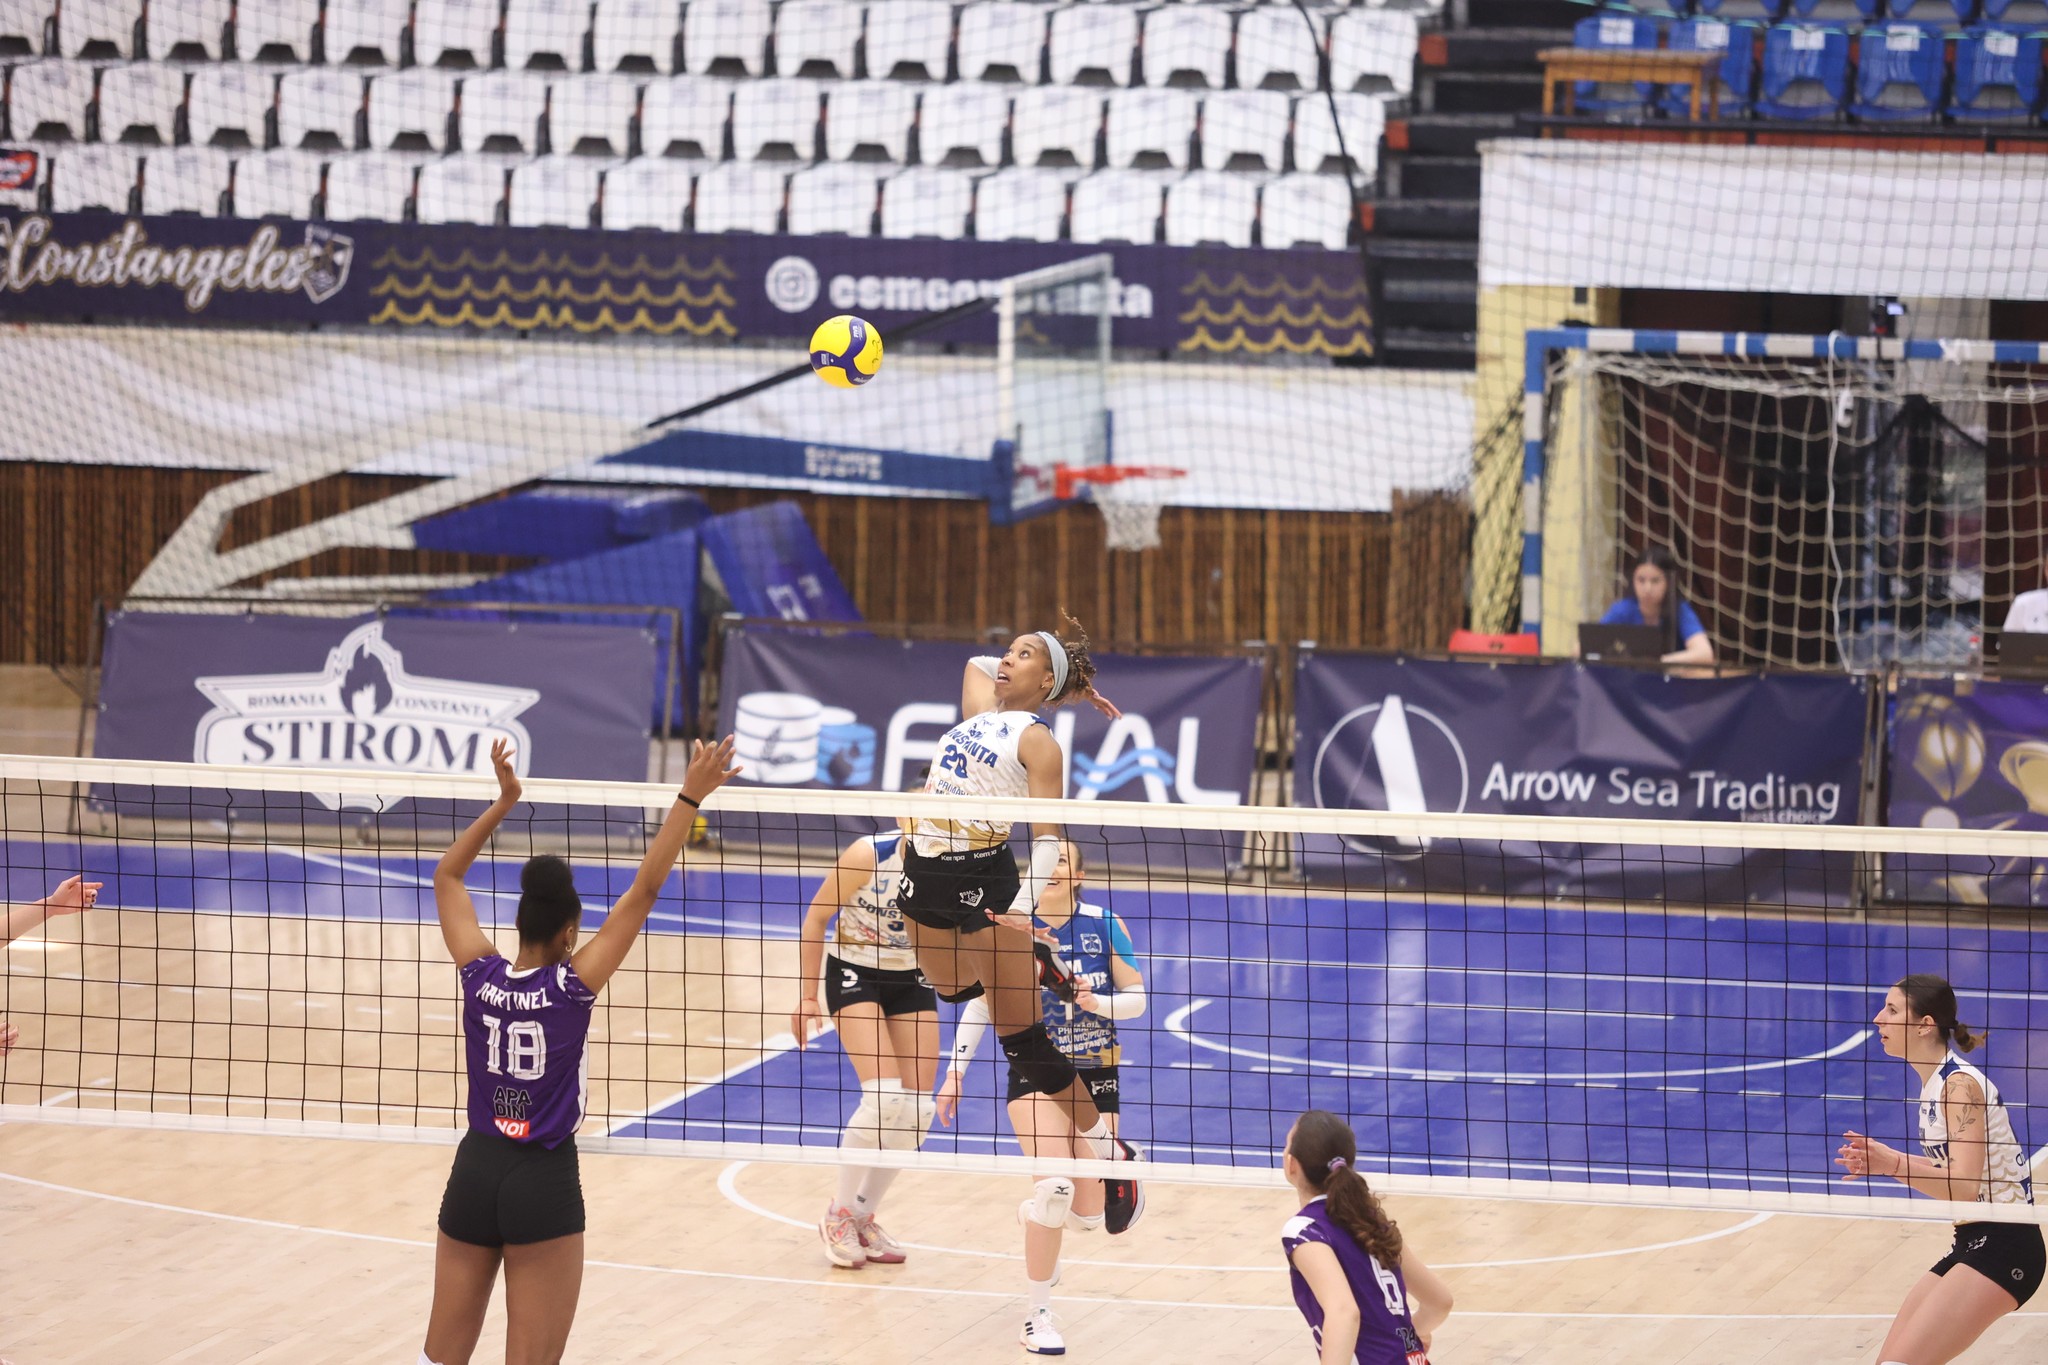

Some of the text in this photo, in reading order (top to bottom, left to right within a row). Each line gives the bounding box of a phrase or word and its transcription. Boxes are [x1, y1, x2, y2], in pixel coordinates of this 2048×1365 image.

[248, 694, 326, 708] ROMANIA
[243, 720, 480, 771] STIROM
[940, 743, 969, 779] 20
[1481, 761, 1841, 819] Arrow Sea Trading
[482, 1014, 547, 1081] 18
[493, 1086, 532, 1107] APA
[495, 1104, 525, 1121] DIN
[495, 1119, 526, 1137] NOI
